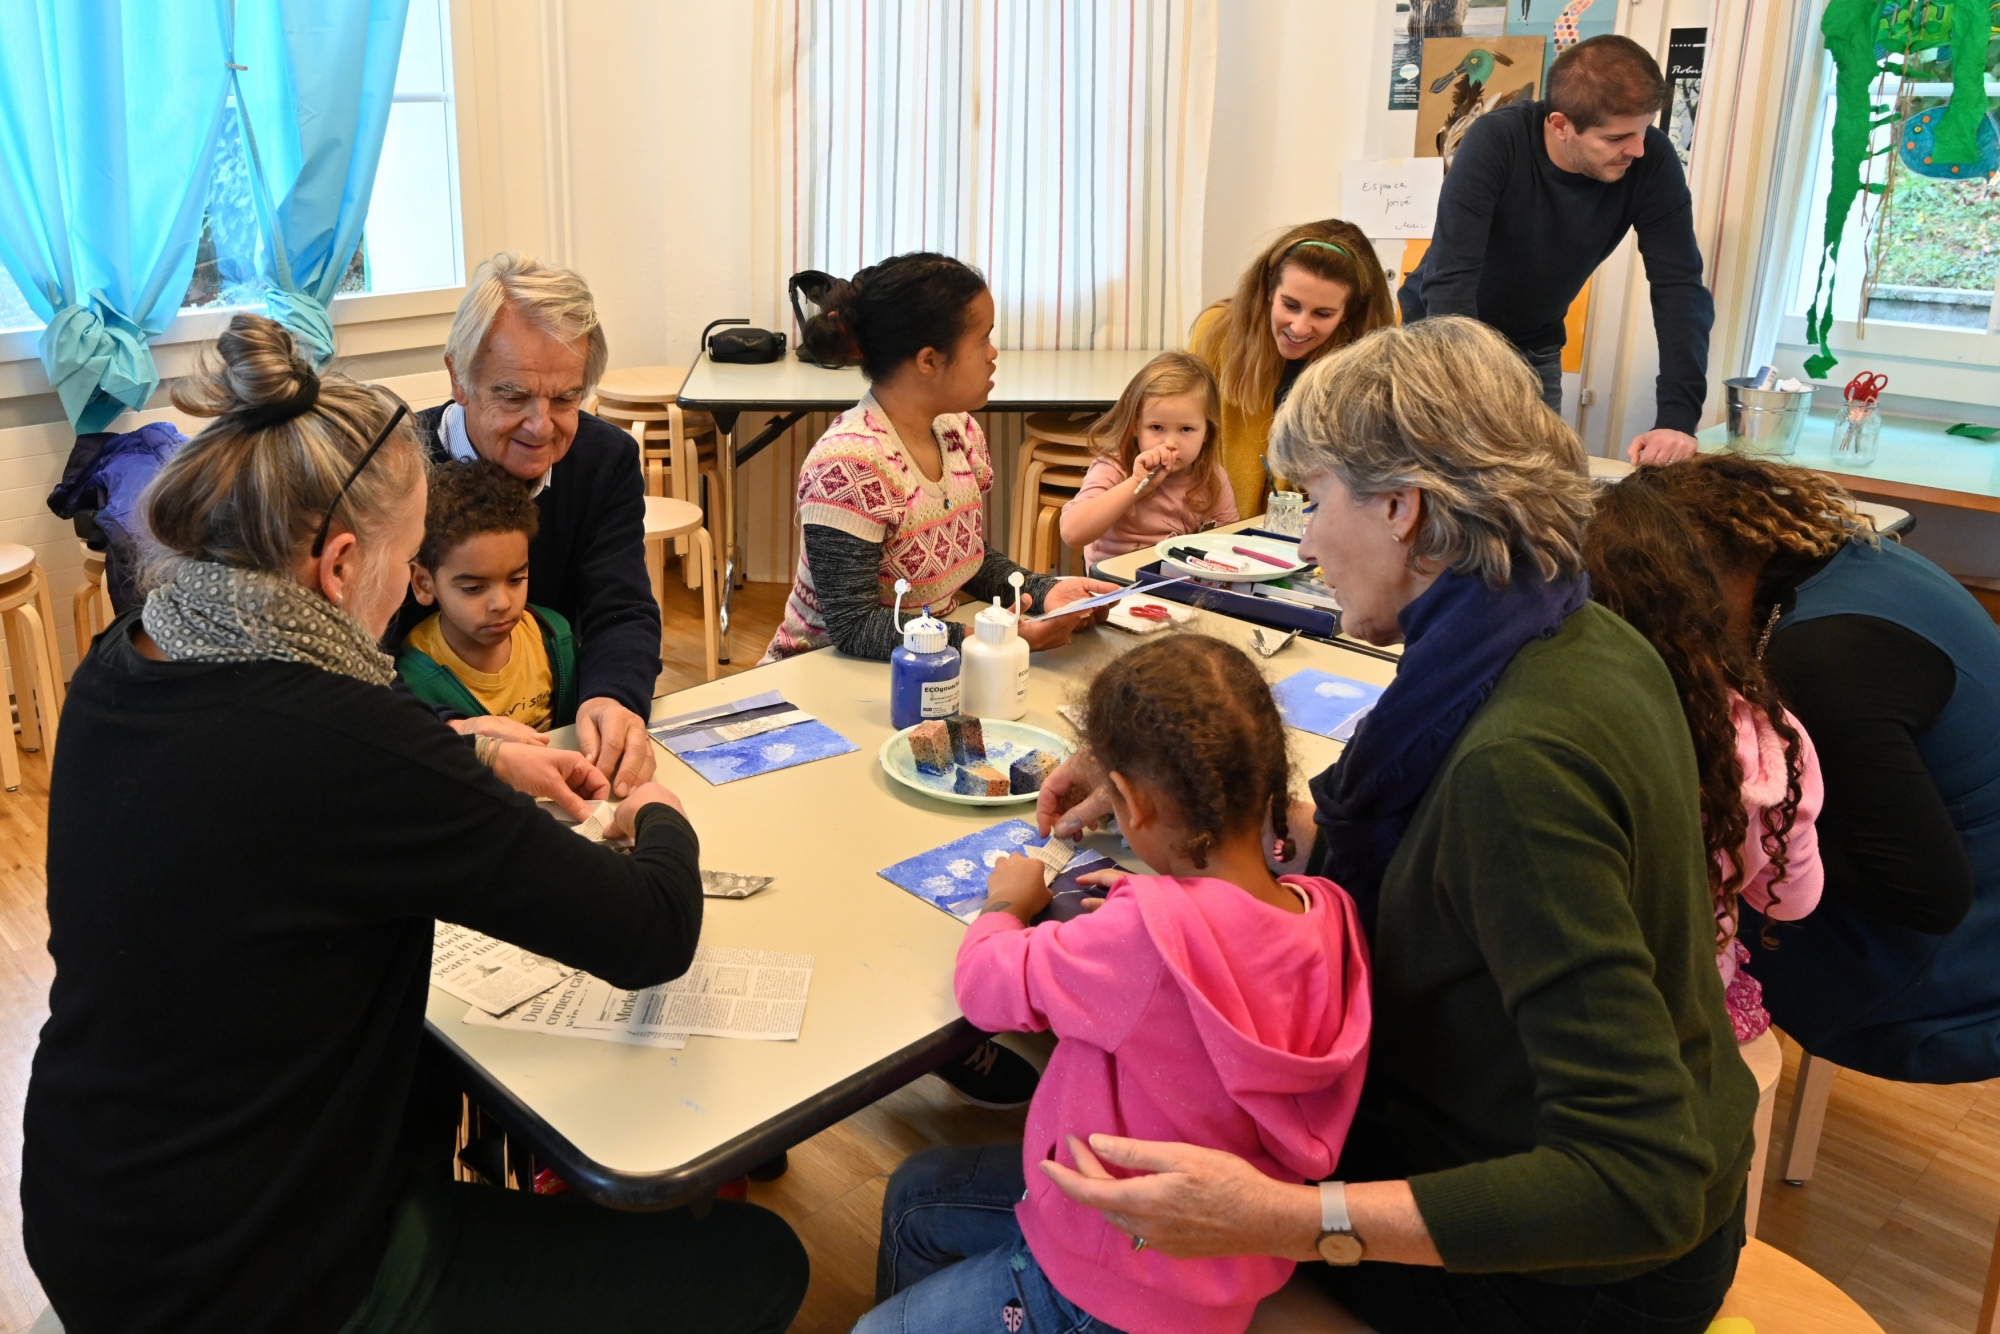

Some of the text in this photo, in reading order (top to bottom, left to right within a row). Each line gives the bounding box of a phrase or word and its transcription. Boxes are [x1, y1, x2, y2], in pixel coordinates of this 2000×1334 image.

[1362, 181, 1408, 196] Espace
[1385, 196, 1412, 215] privé
[435, 932, 468, 950] look
[455, 941, 474, 952] in
[521, 995, 549, 1023] Dull?
[546, 989, 575, 1026] corners
[614, 990, 640, 1023] Morke
